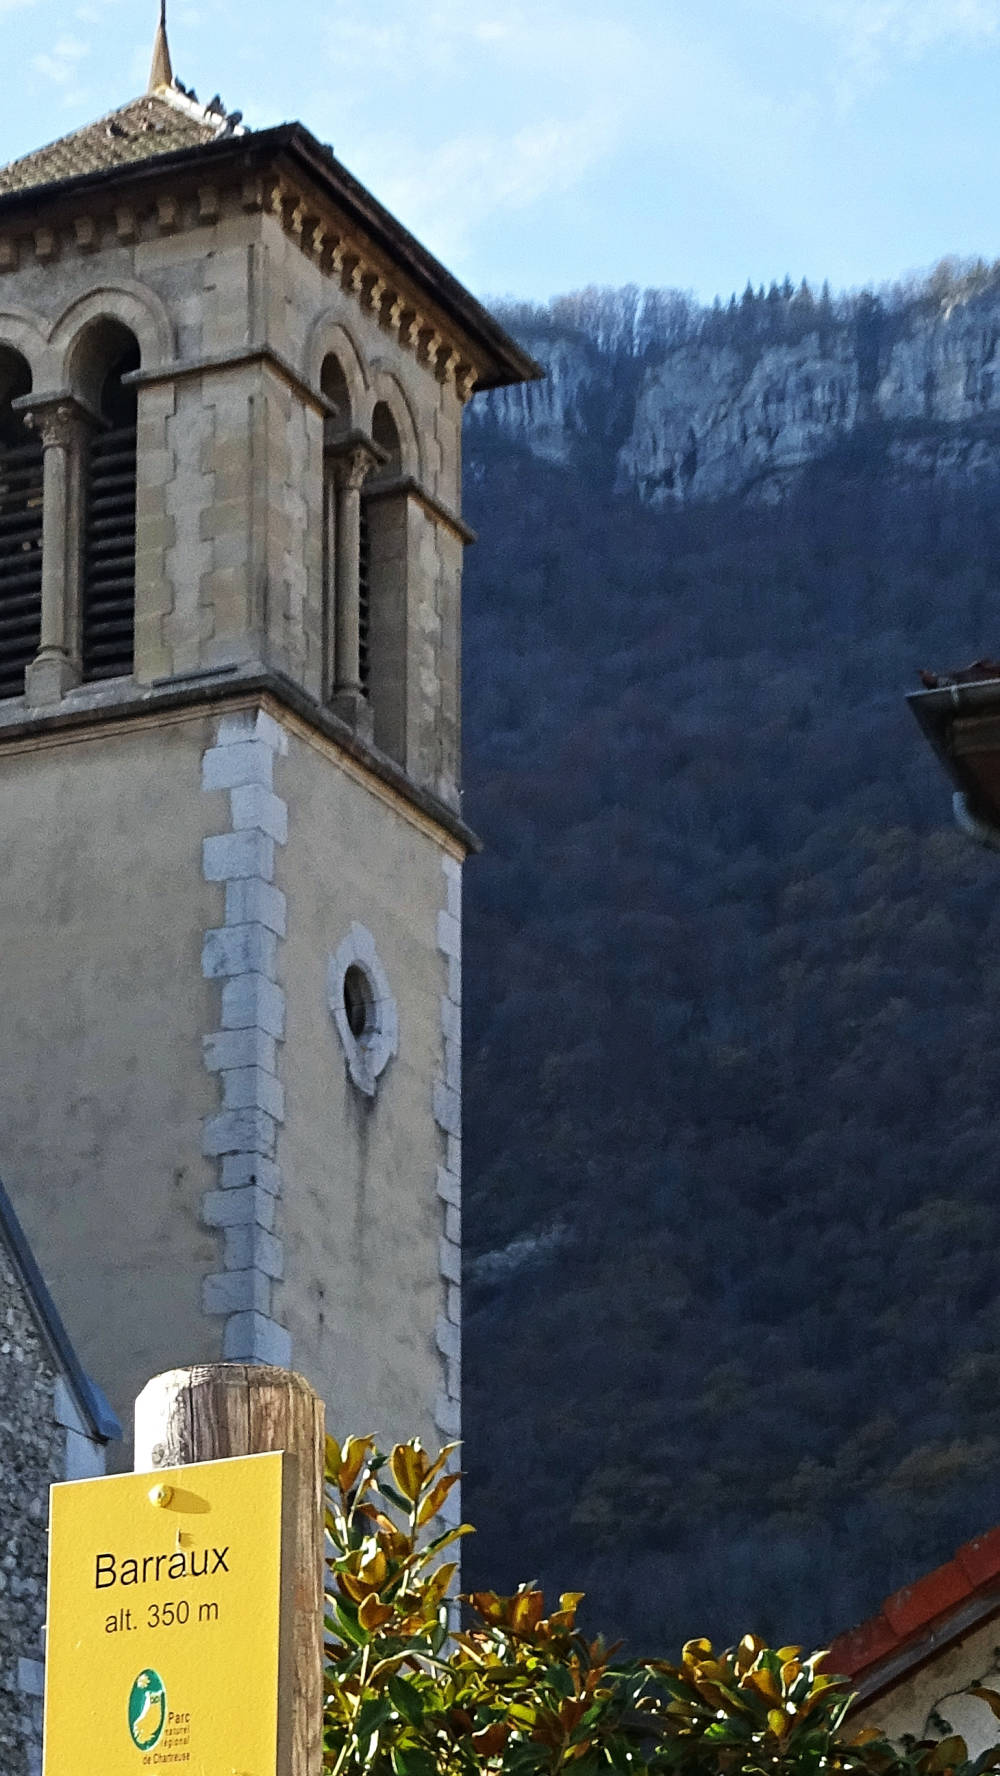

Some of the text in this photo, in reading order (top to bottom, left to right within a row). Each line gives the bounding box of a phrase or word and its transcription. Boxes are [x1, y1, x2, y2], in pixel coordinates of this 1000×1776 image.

[95, 1546, 229, 1589] Barraux
[105, 1600, 219, 1634] alt. 350 m
[168, 1711, 191, 1724] Parc
